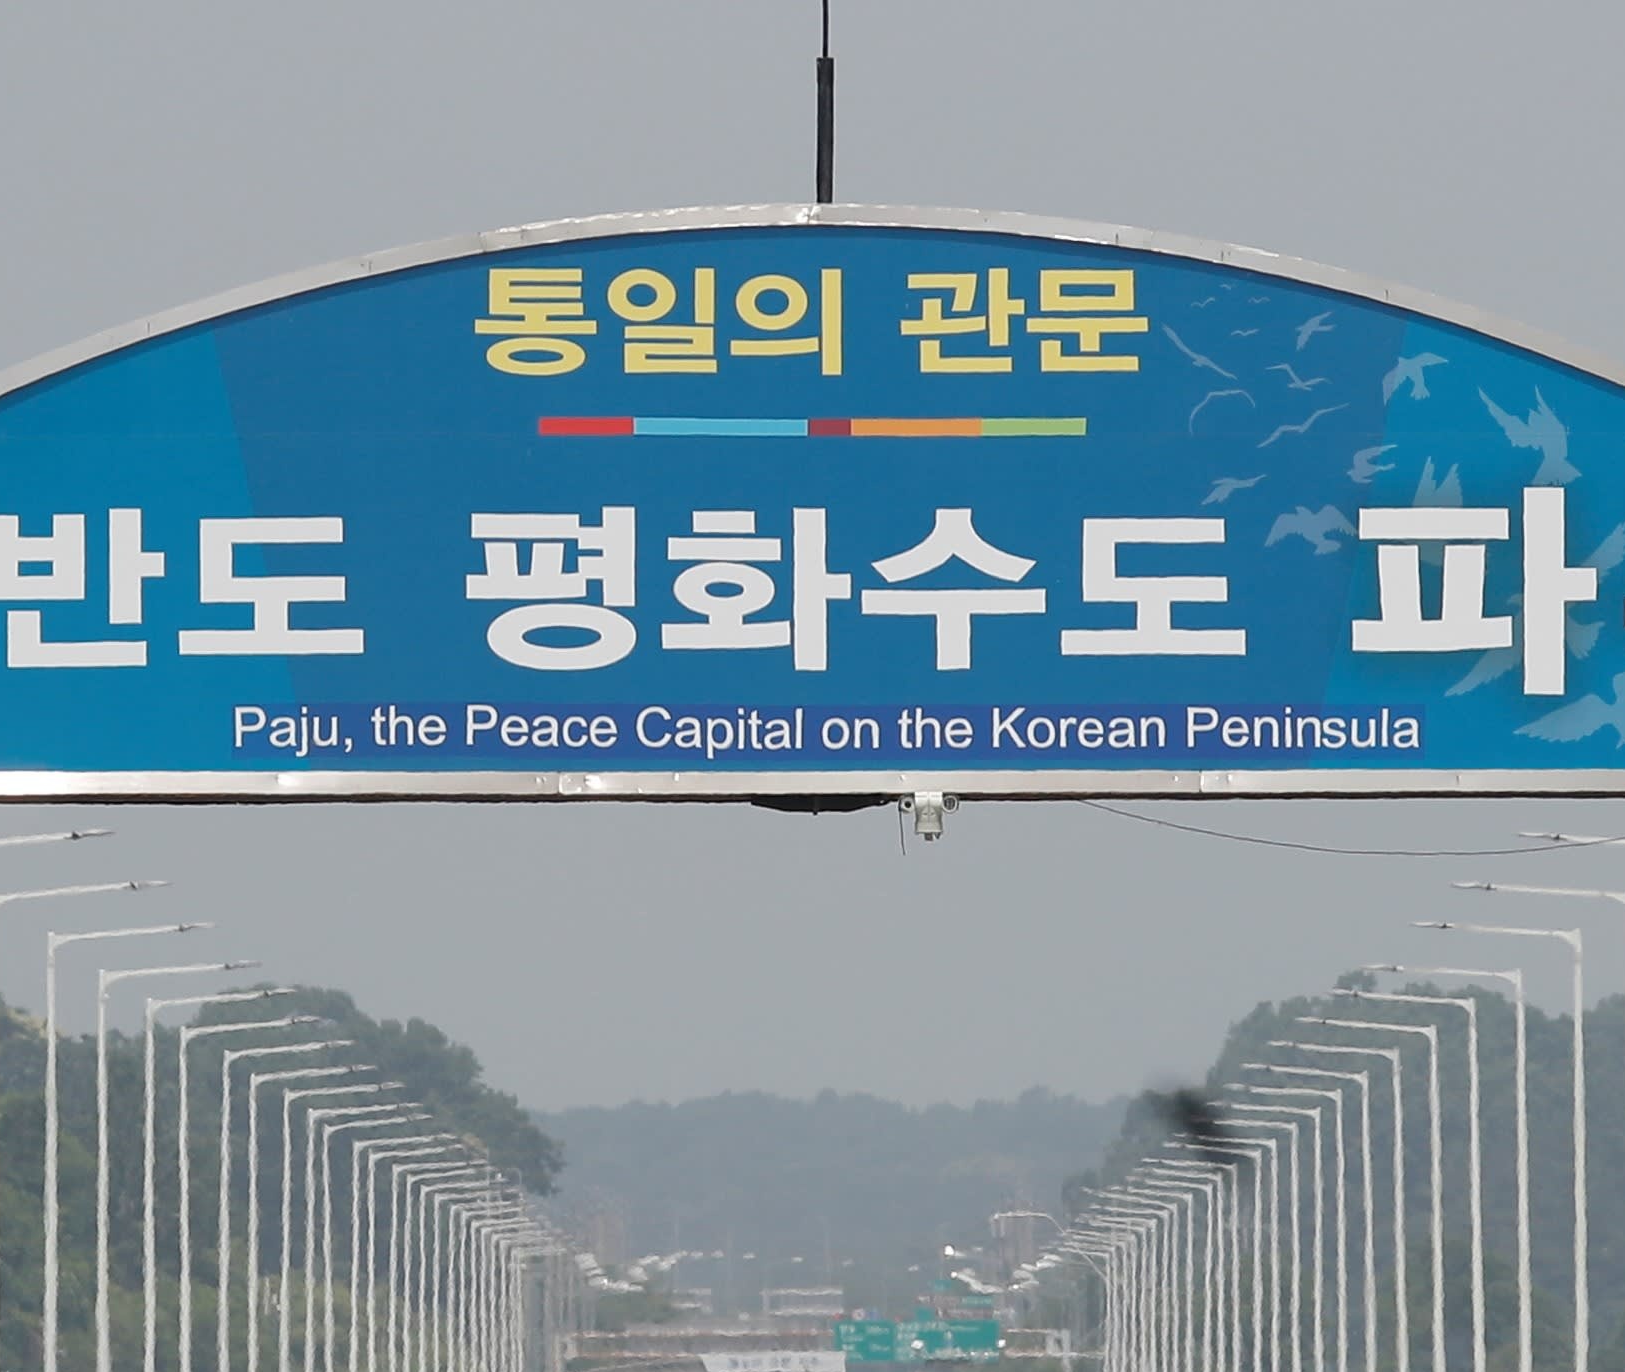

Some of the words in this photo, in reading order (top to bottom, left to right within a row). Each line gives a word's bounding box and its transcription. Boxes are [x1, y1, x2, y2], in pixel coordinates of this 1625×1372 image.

[475, 268, 843, 376] 통일의
[901, 269, 1150, 374] 관문
[465, 506, 1247, 671] 평화수도
[234, 706, 354, 758] Paju,
[369, 705, 448, 747] the
[465, 704, 619, 749] Peace
[635, 706, 804, 760] Capital
[821, 717, 881, 750] on
[896, 707, 974, 749] the
[991, 707, 1167, 749] Korean
[1186, 706, 1420, 750] Peninsula
